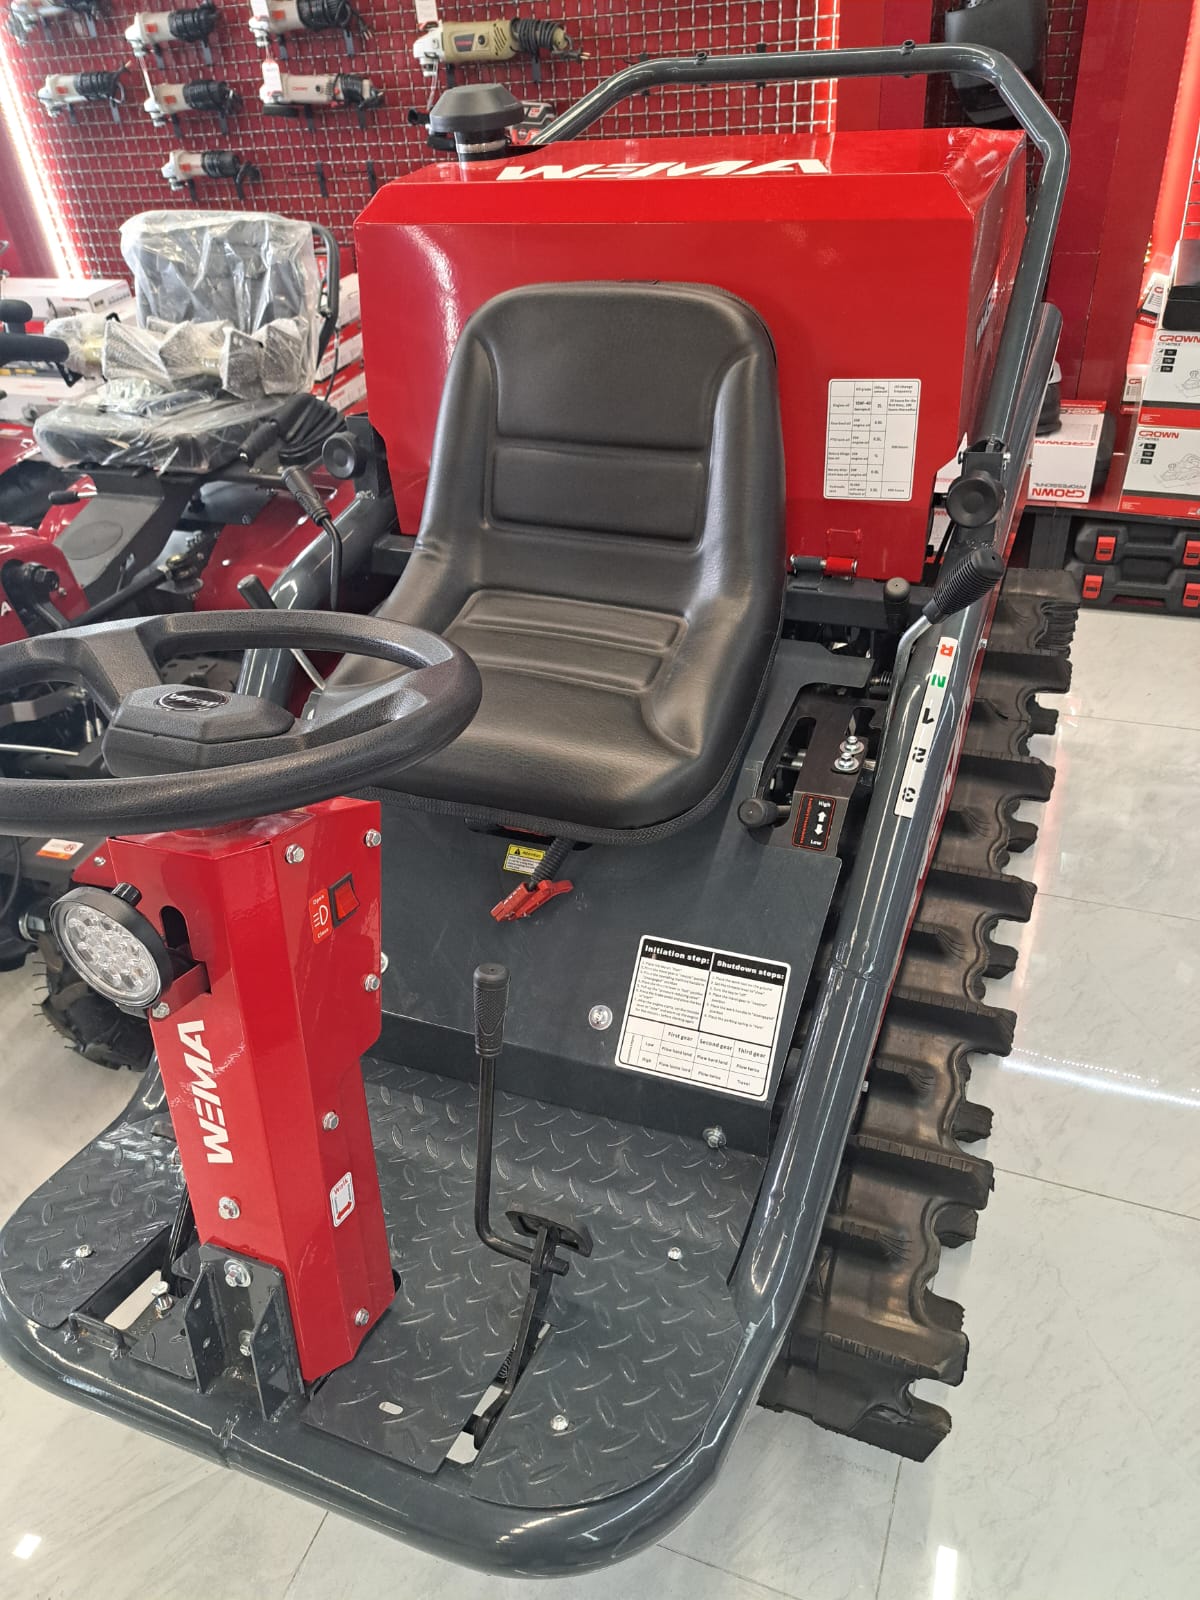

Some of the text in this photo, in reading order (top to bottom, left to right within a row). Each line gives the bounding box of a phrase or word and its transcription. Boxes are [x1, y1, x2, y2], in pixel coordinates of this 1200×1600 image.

[496, 159, 829, 181] WEMA
[1158, 335, 1200, 343] CROWN
[1138, 430, 1180, 439] CROWN
[1031, 487, 1085, 498] CROWN
[902, 643, 954, 803] R N 1 2 3
[818, 800, 831, 808] High
[312, 894, 325, 905] Open
[644, 944, 710, 965] Initiation step:
[716, 959, 757, 974] Shutdown
[699, 1038, 720, 1047] Second
[738, 1047, 752, 1055] Third
[177, 1020, 234, 1164] WEMA
